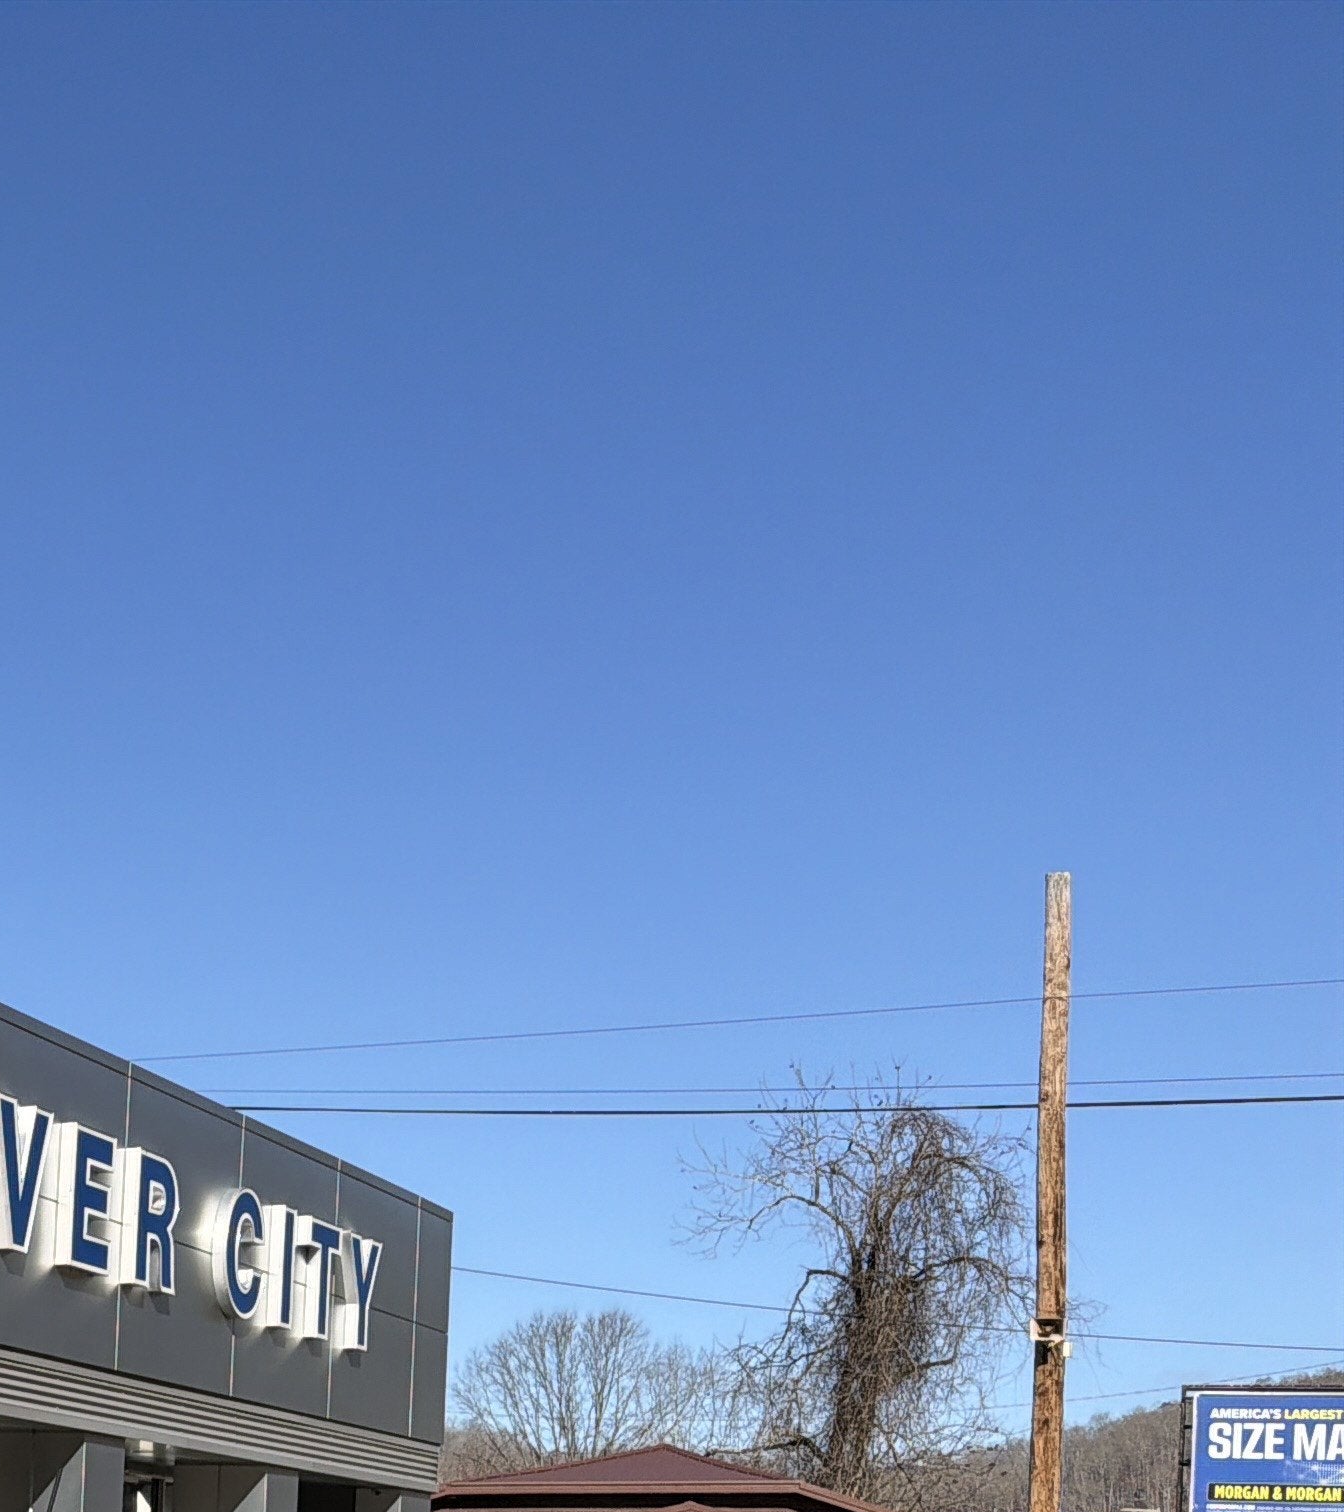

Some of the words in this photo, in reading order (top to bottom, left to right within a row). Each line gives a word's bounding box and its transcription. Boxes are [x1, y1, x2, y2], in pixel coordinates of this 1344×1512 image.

[213, 1187, 383, 1353] CITY
[1210, 1407, 1282, 1420] AMERICA'S
[1284, 1408, 1344, 1421] LARGEST
[1207, 1421, 1286, 1461] SIZE
[1214, 1484, 1270, 1501] MORGAN
[1272, 1485, 1283, 1501] &
[1285, 1486, 1343, 1502] MORGAN
